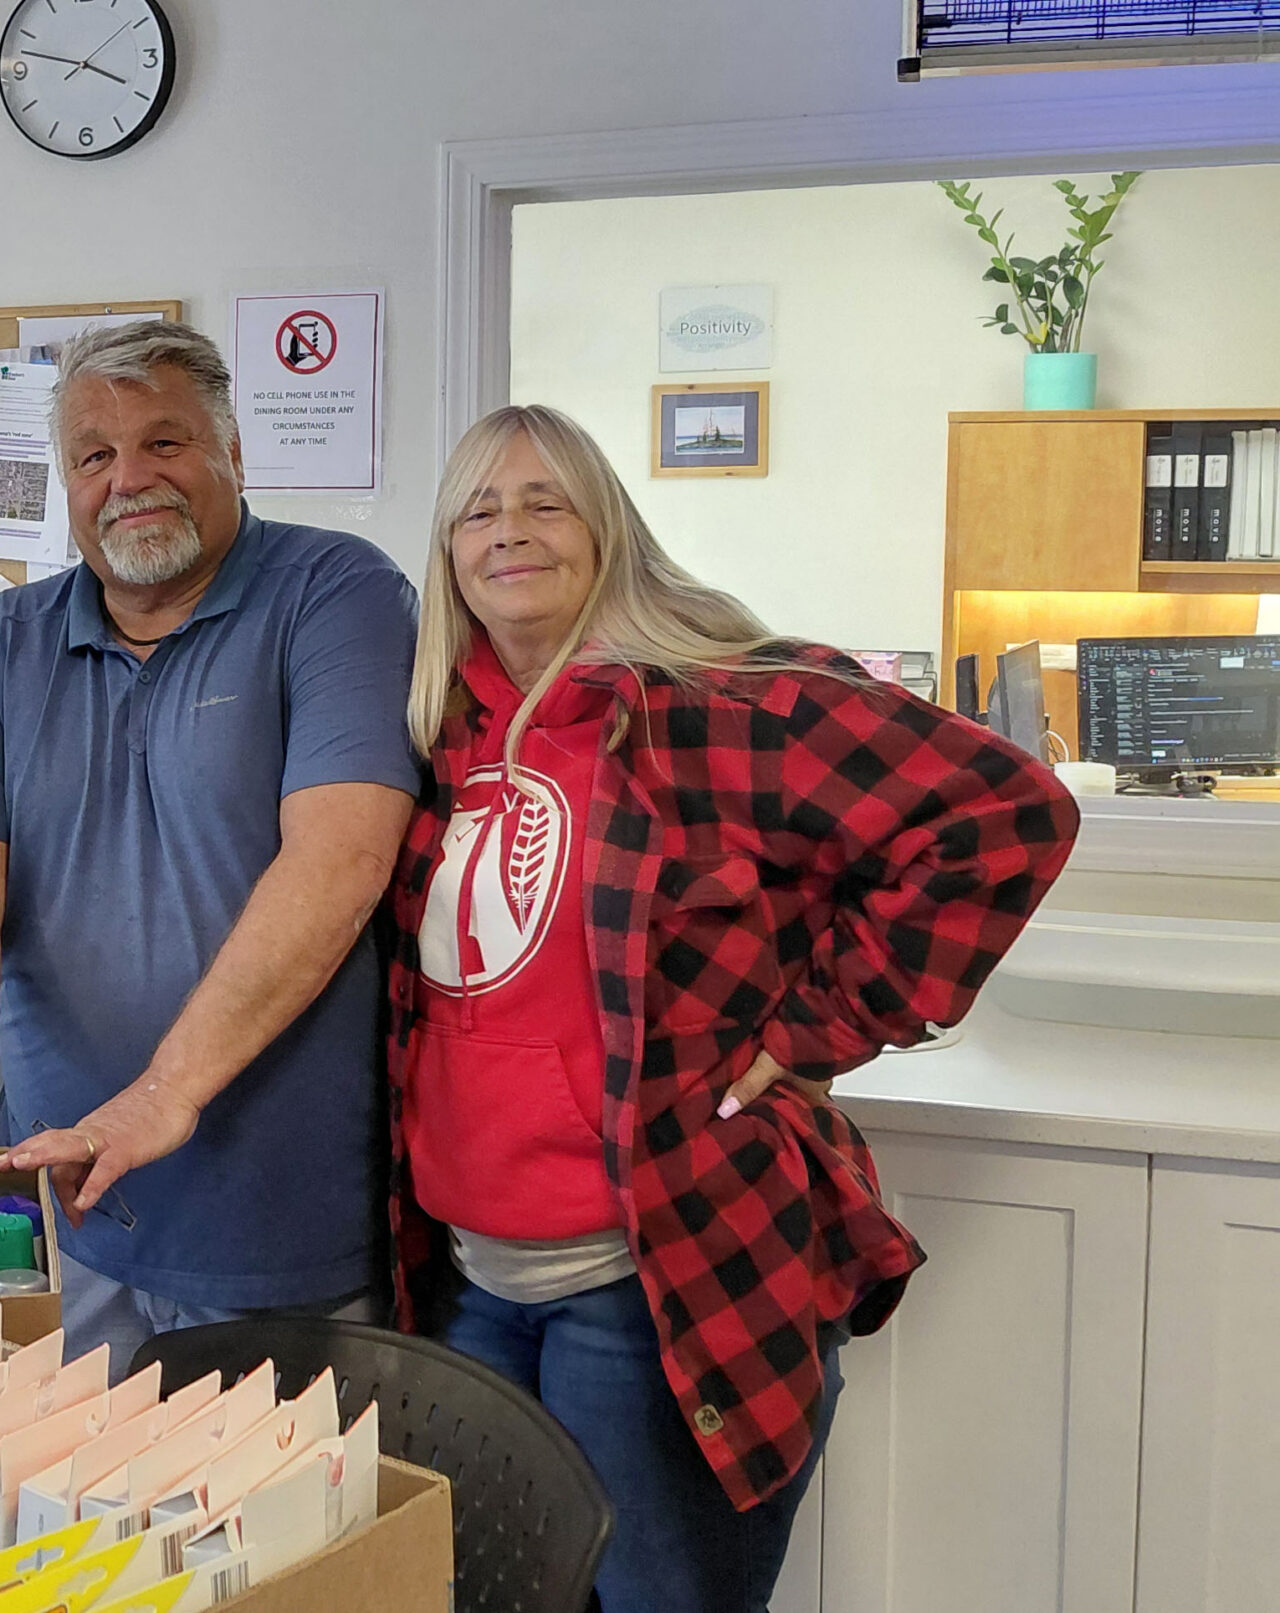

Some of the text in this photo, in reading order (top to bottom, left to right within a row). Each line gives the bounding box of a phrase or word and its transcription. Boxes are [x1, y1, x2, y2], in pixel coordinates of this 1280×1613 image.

[143, 48, 158, 68] 3
[13, 61, 28, 81] 9
[78, 127, 94, 146] 6
[680, 320, 752, 336] Positivity
[253, 392, 265, 400] NO
[286, 391, 312, 399] PHONE
[340, 390, 355, 398] THE
[254, 407, 281, 415] DINING
[338, 406, 354, 414] ANY
[272, 422, 335, 430] CIRCUMSTANCES
[308, 437, 327, 445] TIME
